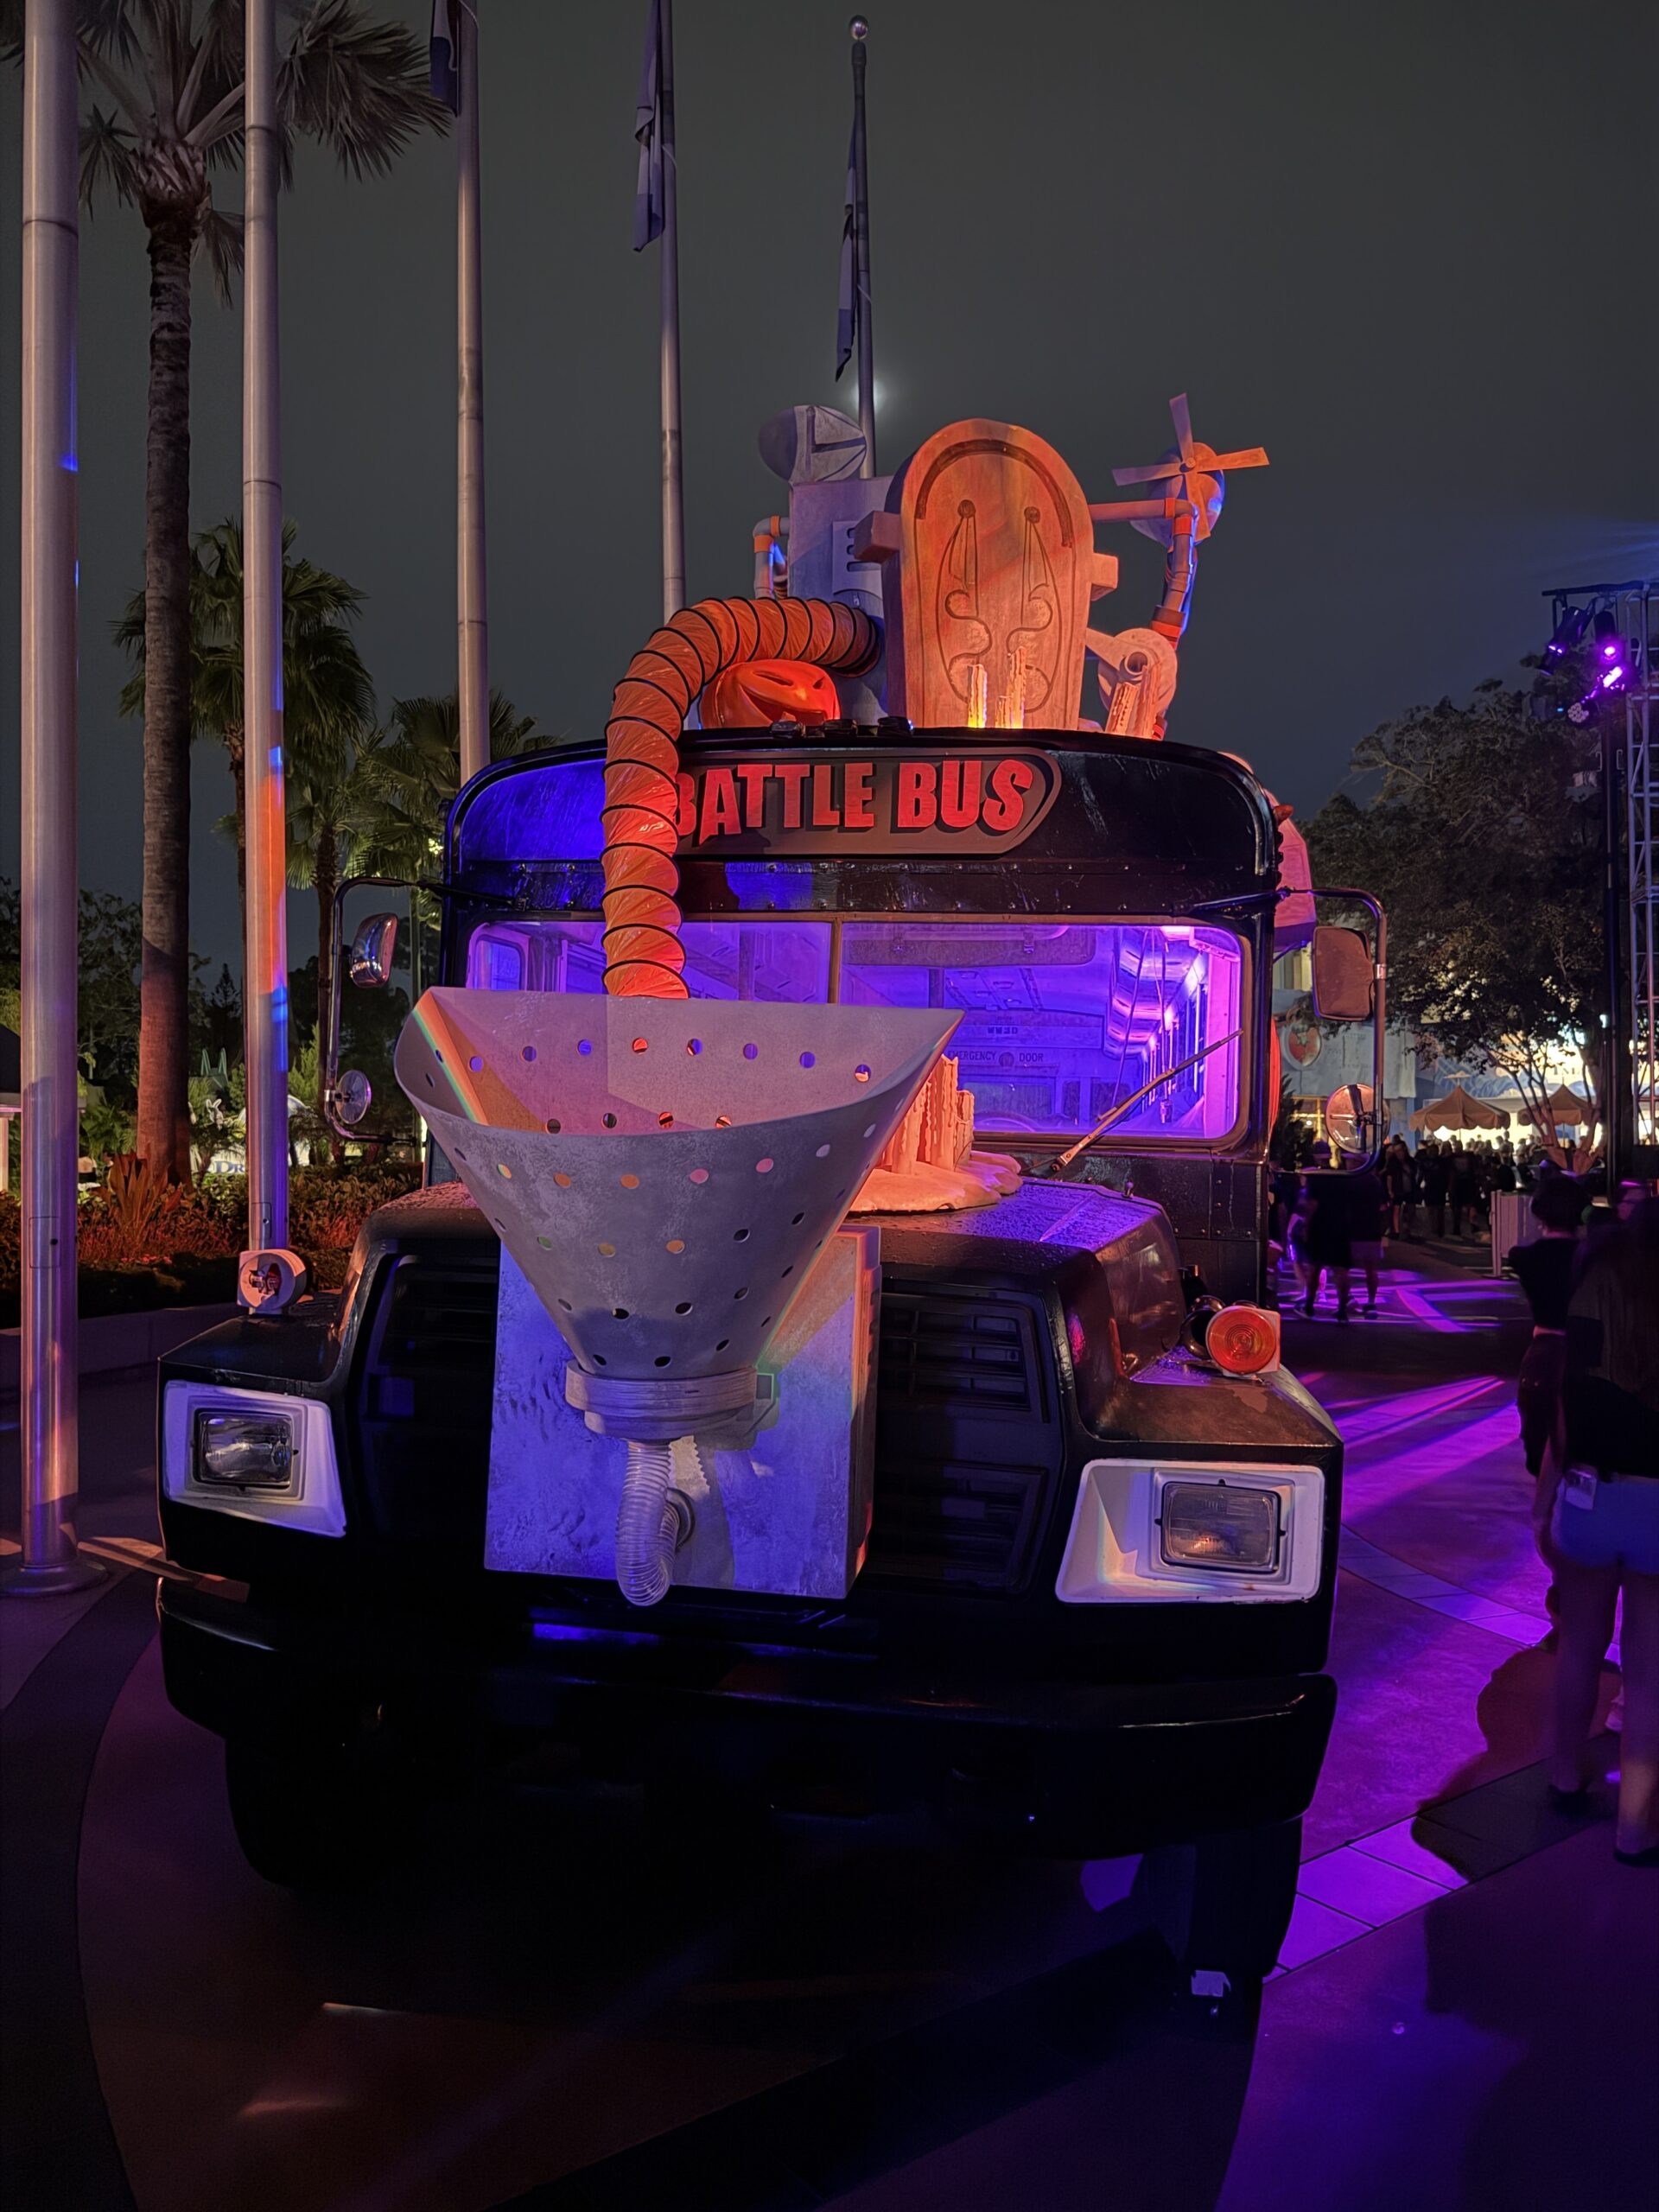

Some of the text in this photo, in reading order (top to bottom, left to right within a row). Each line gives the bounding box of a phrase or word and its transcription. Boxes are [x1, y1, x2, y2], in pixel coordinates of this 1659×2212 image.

[675, 759, 1033, 845] BATTLE BUS
[1019, 1052, 1044, 1062] DOOR
